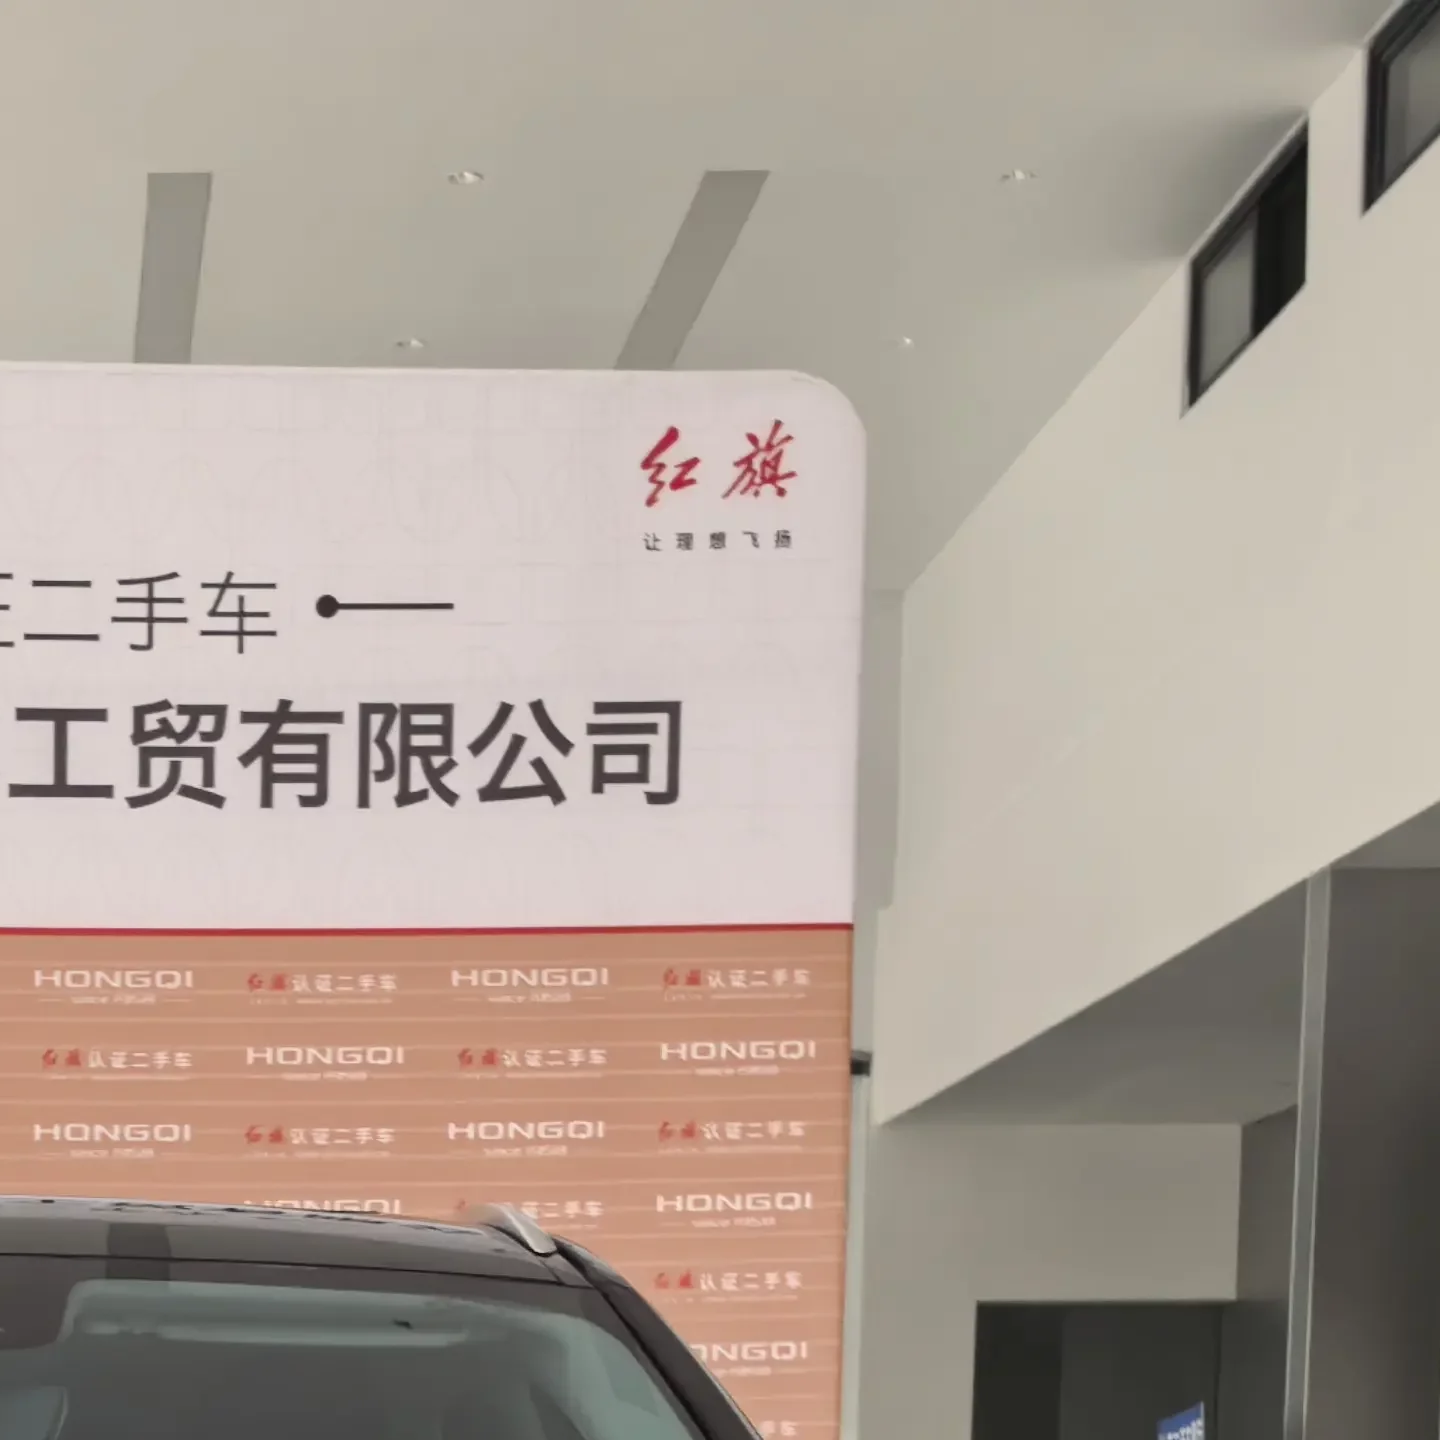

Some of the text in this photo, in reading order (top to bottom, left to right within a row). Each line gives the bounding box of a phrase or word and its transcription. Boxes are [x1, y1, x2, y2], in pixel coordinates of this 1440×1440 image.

[639, 418, 798, 508] 红旗
[642, 529, 793, 551] 让理想飞扬
[33, 969, 193, 989] HONGQI
[451, 967, 609, 987] HONGQI
[245, 1046, 405, 1065] HONGQI
[660, 1040, 816, 1061] HONGQI
[33, 1123, 192, 1142] HONGQI
[447, 1120, 605, 1140] HONGQI
[656, 1192, 812, 1213] HONGQI
